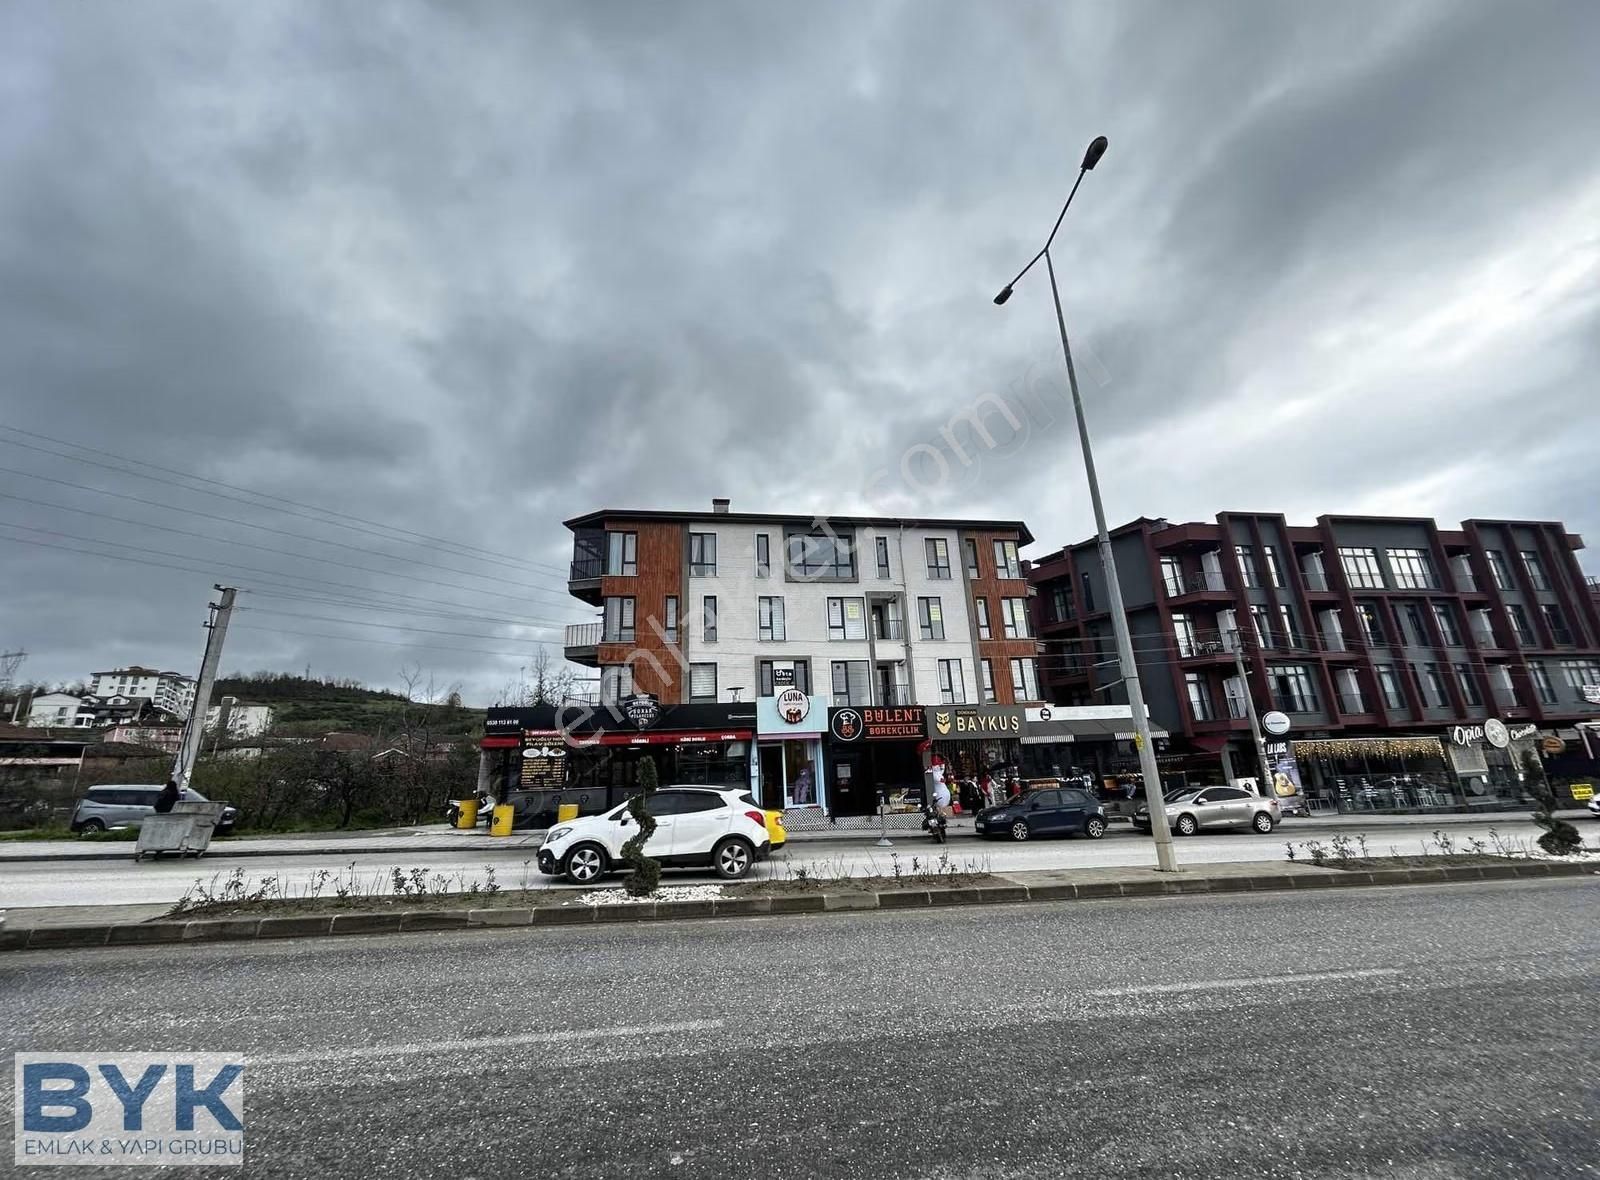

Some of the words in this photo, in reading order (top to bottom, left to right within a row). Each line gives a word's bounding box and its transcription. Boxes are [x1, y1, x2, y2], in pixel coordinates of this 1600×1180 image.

[783, 692, 803, 702] LUNA
[956, 715, 1020, 734] BAYKUŞ
[1453, 725, 1484, 747] Opia
